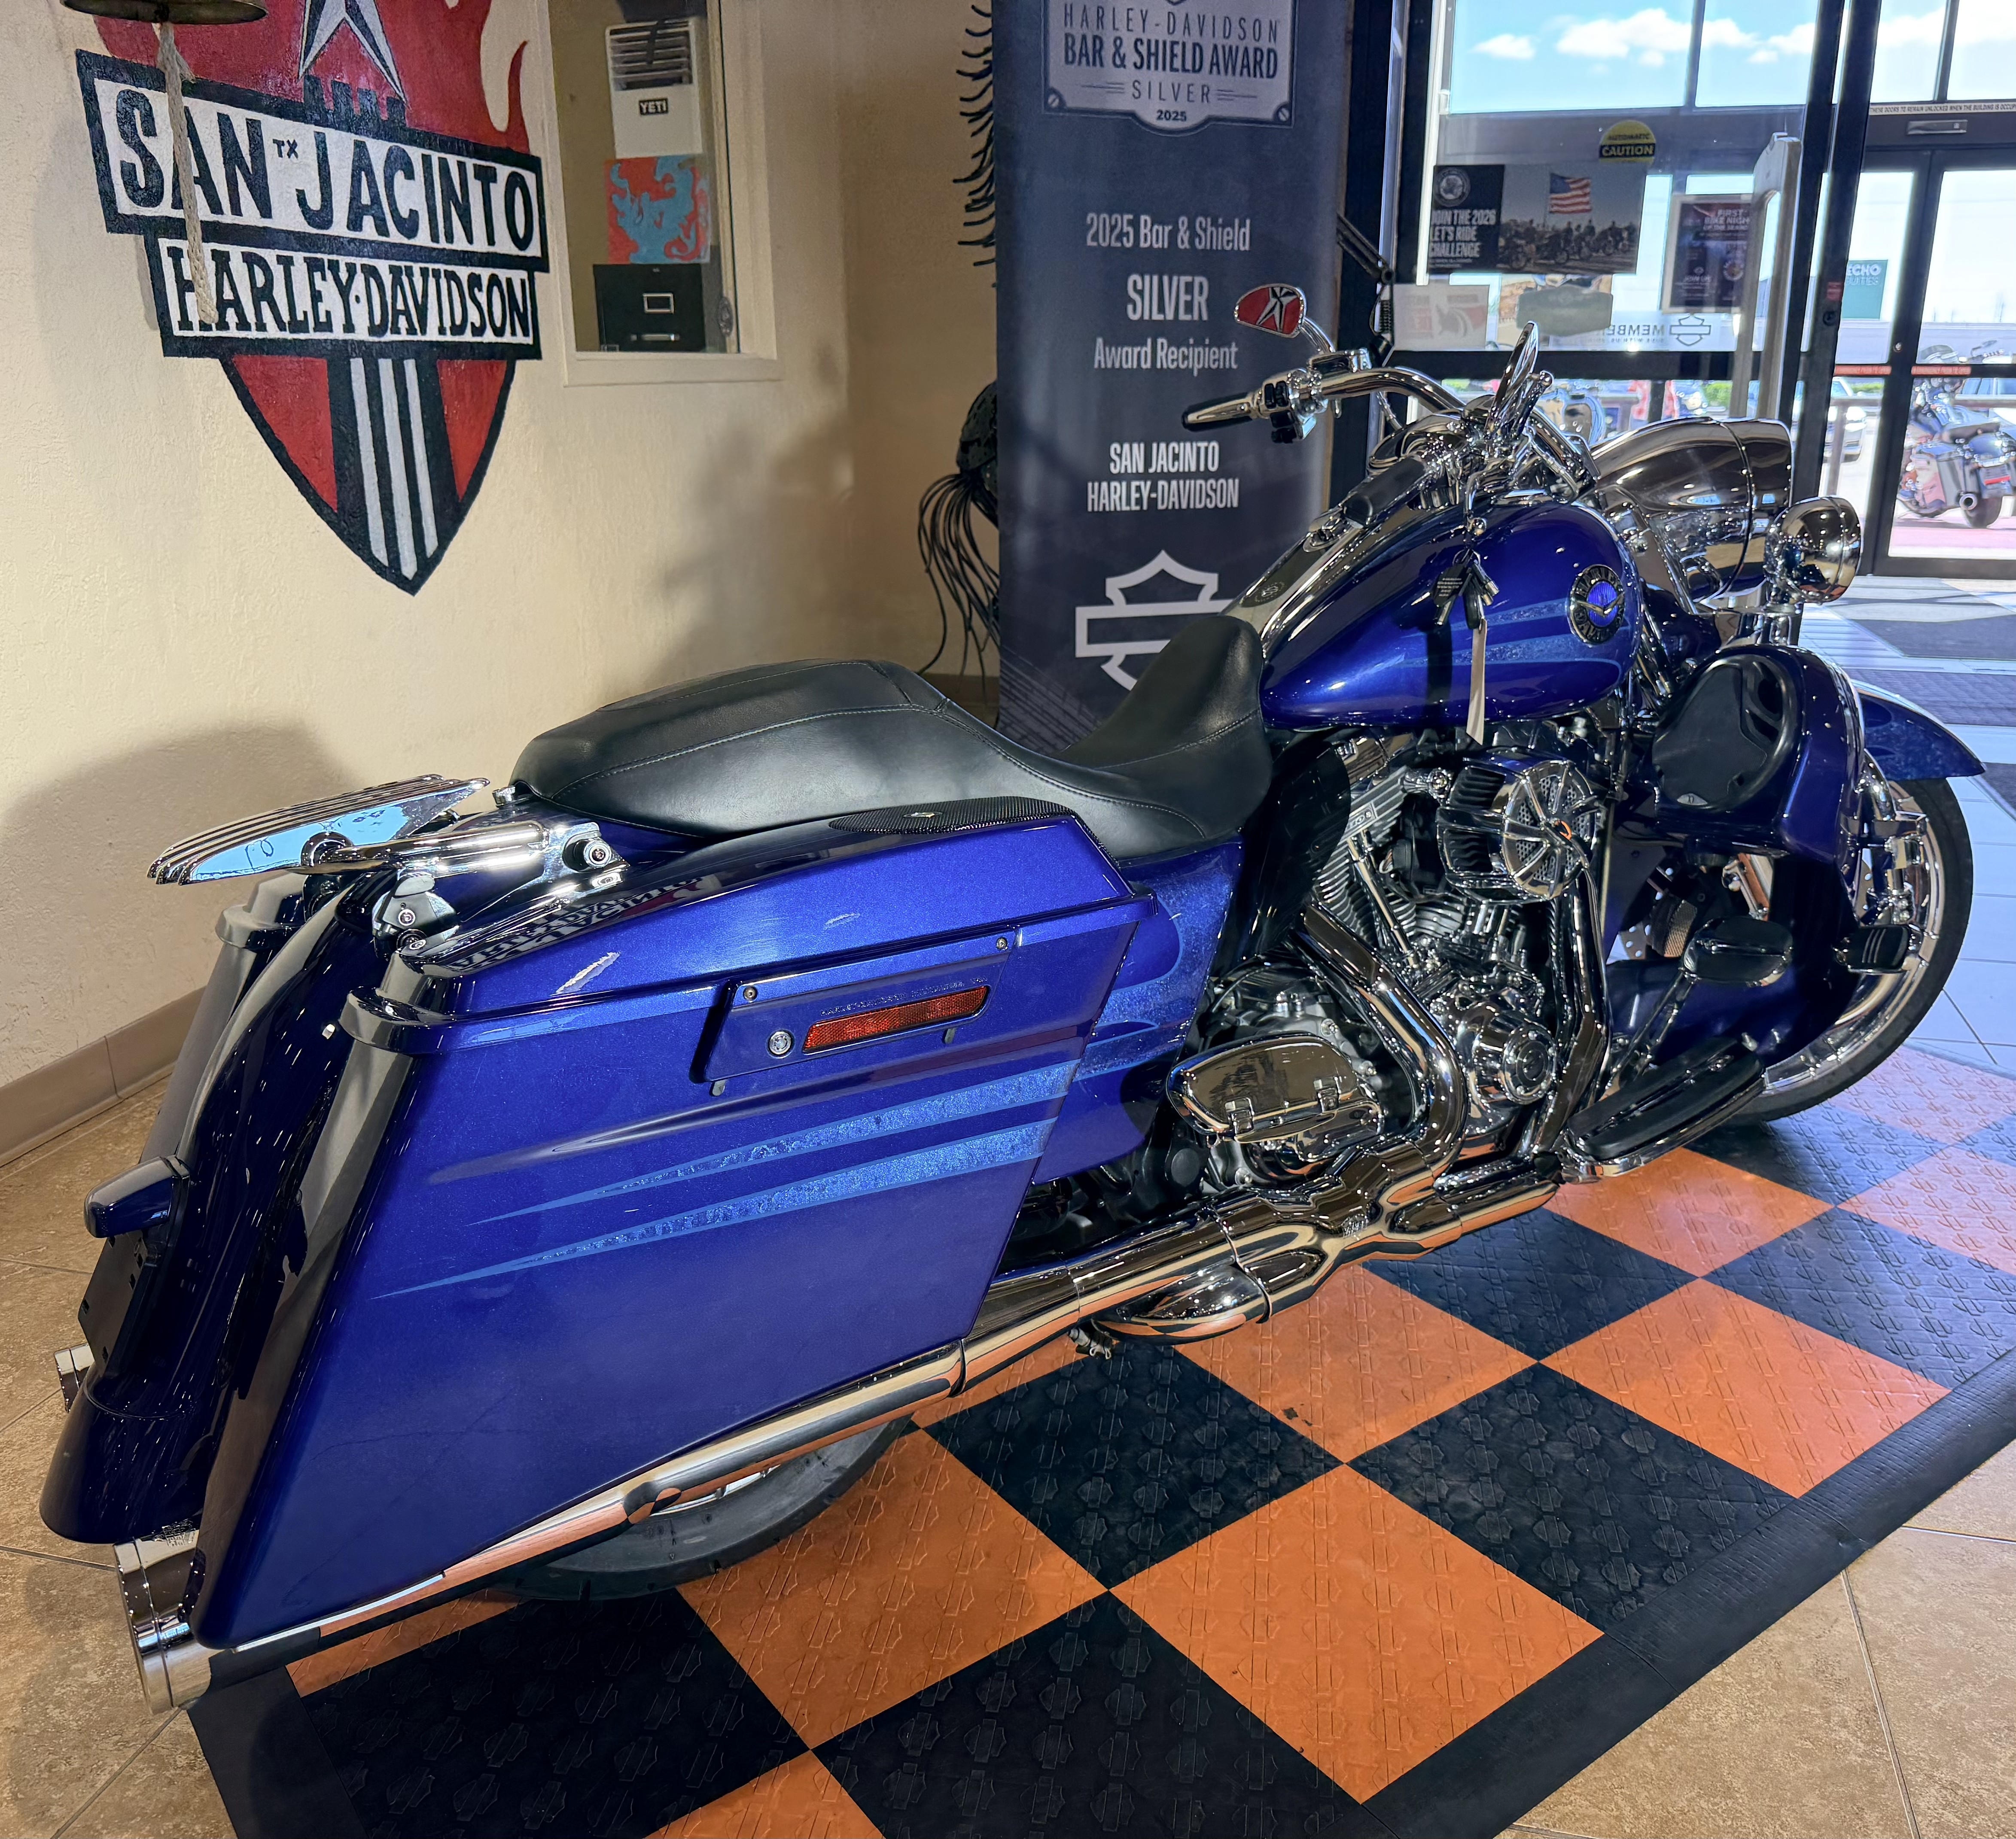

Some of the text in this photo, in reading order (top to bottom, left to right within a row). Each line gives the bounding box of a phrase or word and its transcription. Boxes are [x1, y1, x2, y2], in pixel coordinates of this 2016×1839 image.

[1064, 3, 1278, 44] HARLEY-DAVIDSON
[1064, 32, 1278, 79] BAR & SHIELD AWARD
[640, 100, 667, 114] YETI
[1132, 80, 1211, 103] SILVER
[1156, 109, 1188, 122] 2025
[1602, 145, 1654, 157] CAUTION
[116, 88, 535, 252] SAN TX JACINTO
[1086, 213, 1251, 251] 2025 Bar & Shield
[1846, 264, 1882, 276] ECHO
[1126, 274, 1209, 321] SILVER
[1093, 337, 1239, 377] Award Recipient
[1109, 440, 1220, 474] SAN JACINTO
[1087, 477, 1239, 512] HARLEY-DAVIDSON
